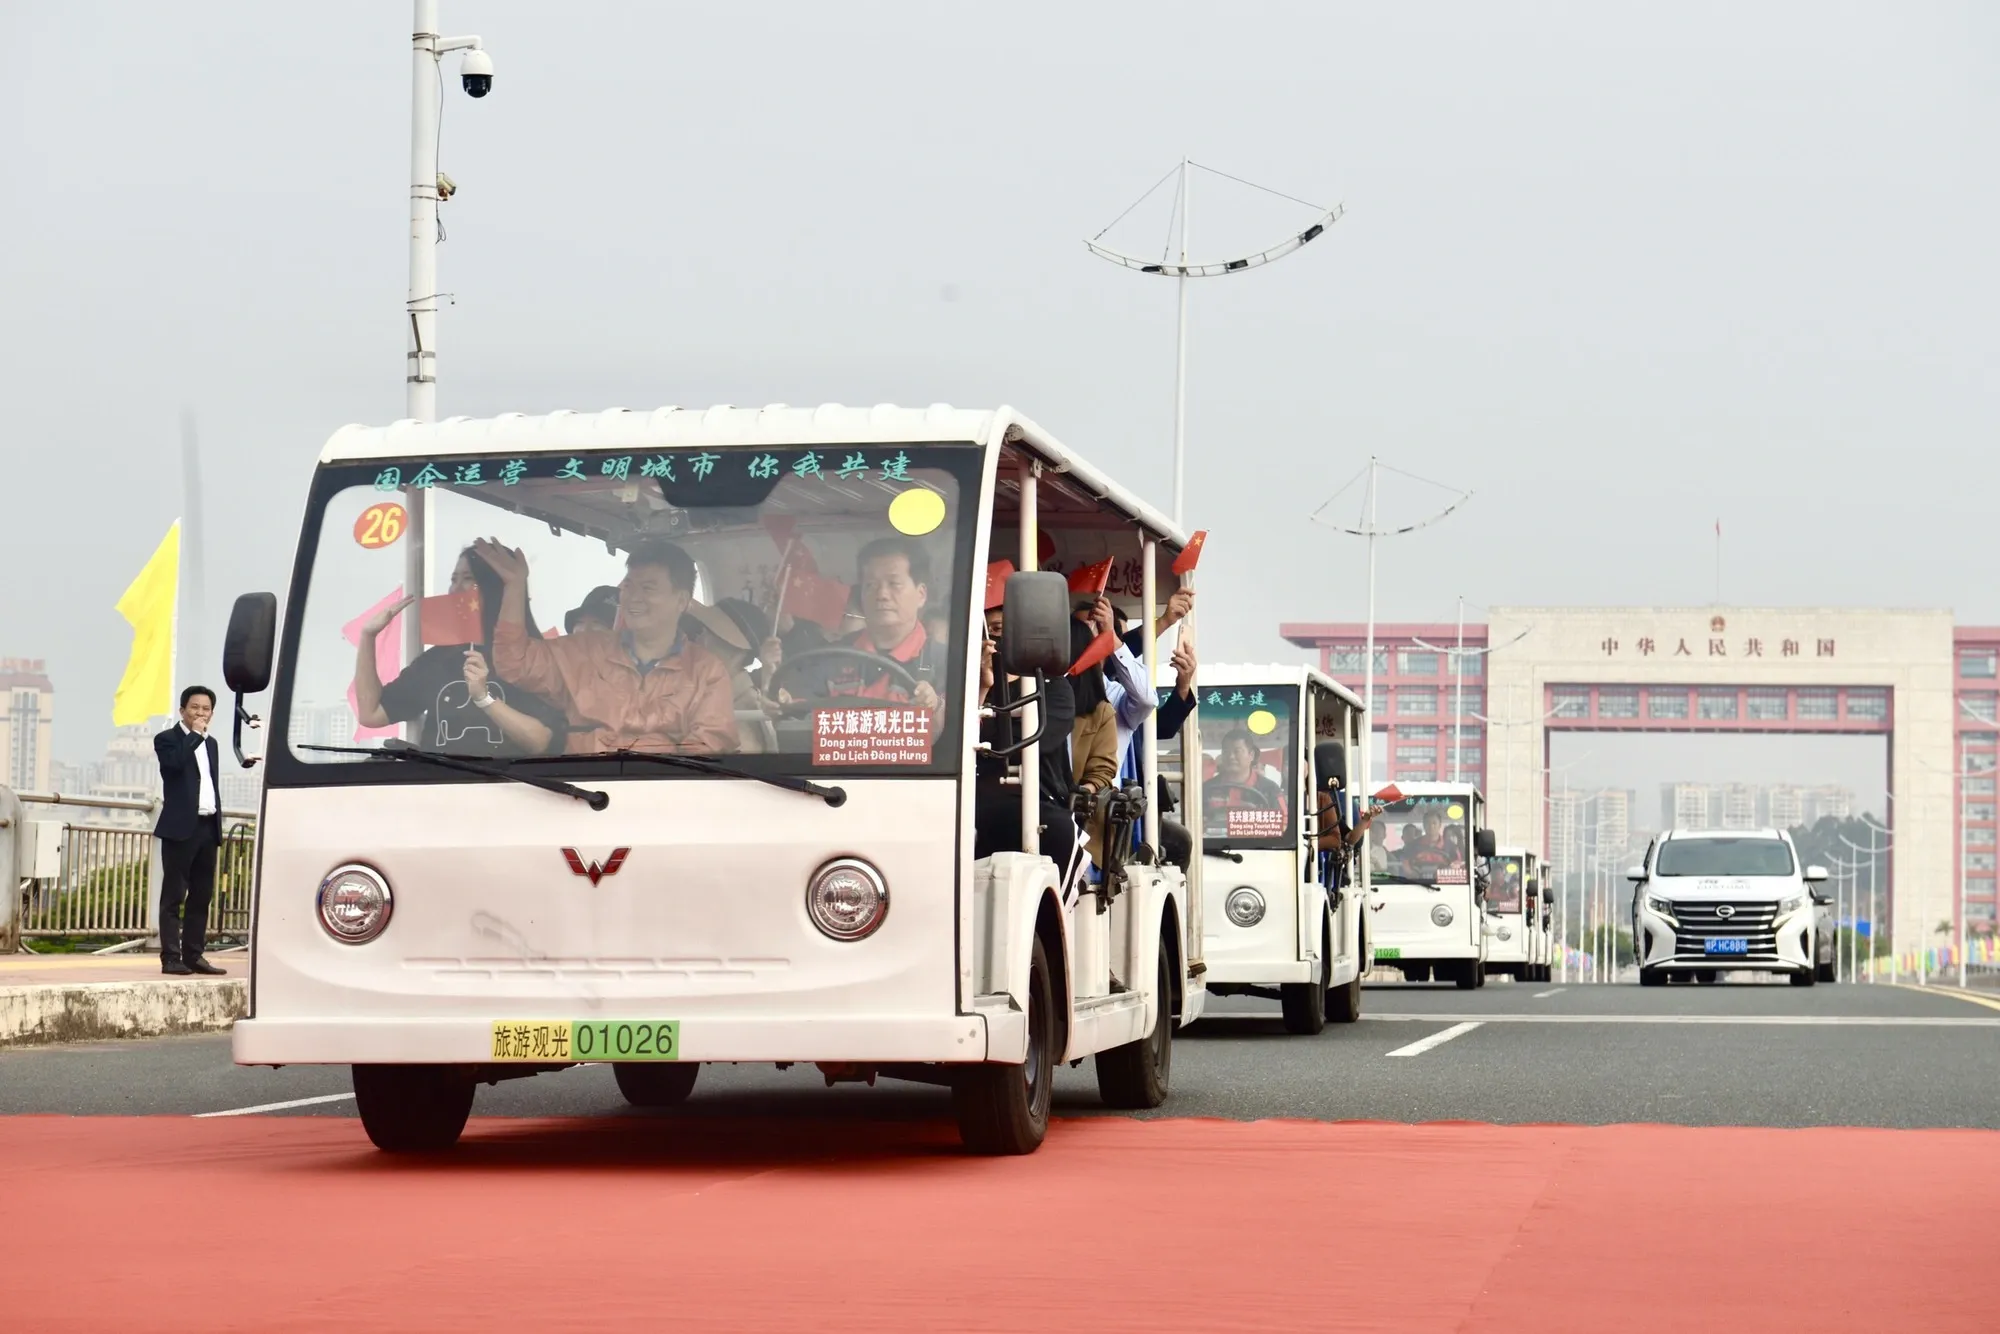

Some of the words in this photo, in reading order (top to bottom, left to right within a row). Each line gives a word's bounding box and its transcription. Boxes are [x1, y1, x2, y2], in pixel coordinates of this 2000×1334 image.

[373, 458, 528, 493] 国企运营
[554, 452, 722, 483] 文明城市
[747, 450, 915, 482] 你我共建
[359, 506, 401, 545] 26
[1601, 637, 1835, 657] 中华人民共和国
[1196, 689, 1268, 706] 我共建
[817, 709, 930, 735] 东兴旅游观光巴士
[819, 738, 846, 749] Dong
[847, 737, 868, 749] xing
[870, 736, 904, 747] Tourist
[906, 736, 925, 747] Bus
[819, 752, 831, 761] xe
[832, 751, 846, 760] Du
[848, 750, 868, 762] Lịch
[899, 750, 928, 762] Hưng
[493, 1024, 569, 1059] 旅游观光
[577, 1024, 673, 1055] 01026
